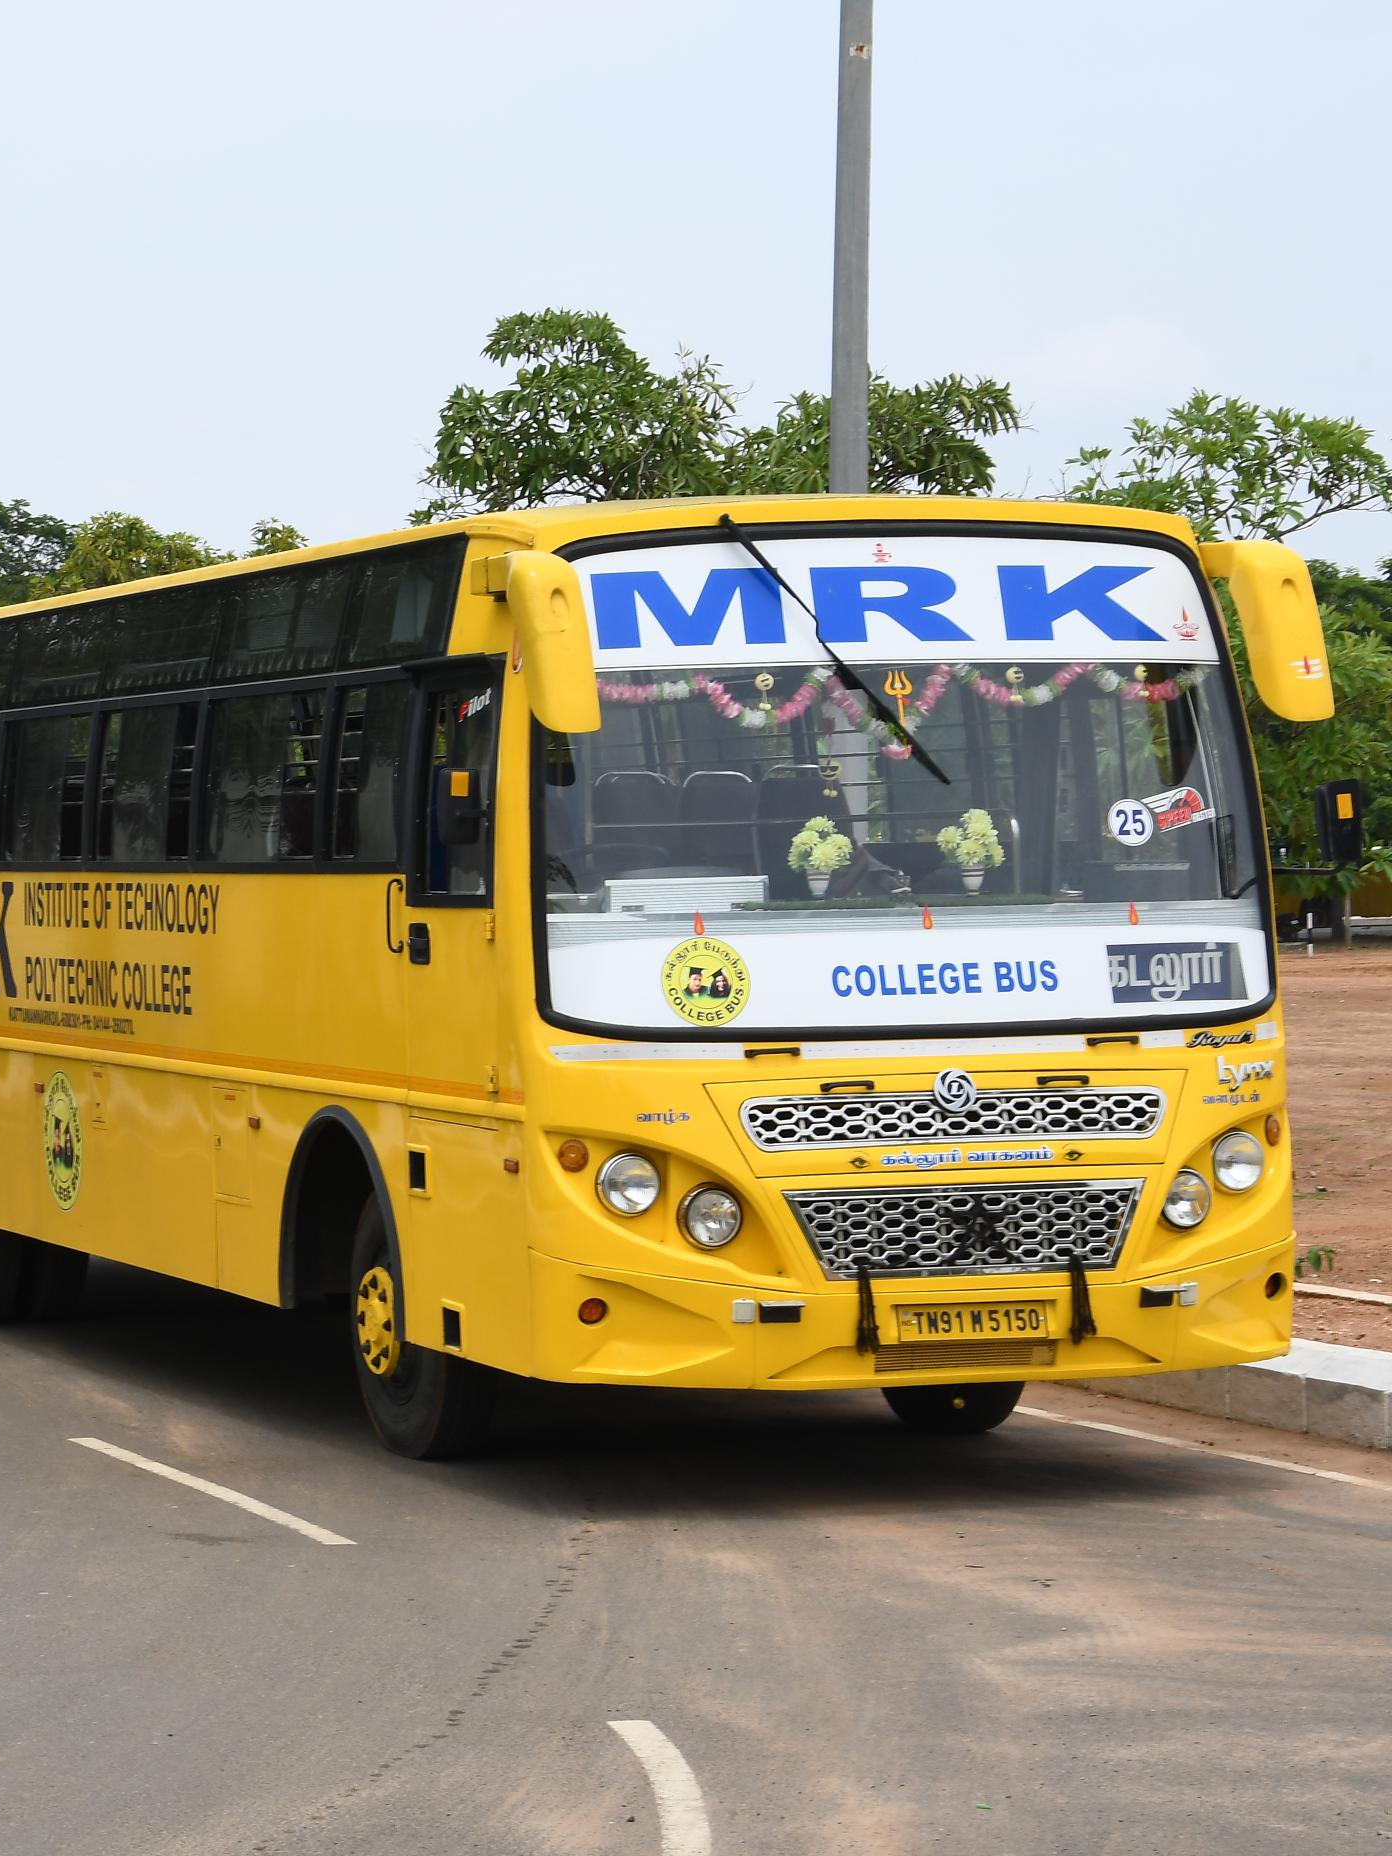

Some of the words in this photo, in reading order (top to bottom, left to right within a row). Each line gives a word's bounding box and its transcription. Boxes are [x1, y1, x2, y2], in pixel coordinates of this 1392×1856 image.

[589, 565, 1168, 651] MRK
[1115, 808, 1146, 836] 25
[24, 882, 89, 929] INSTITUTE
[93, 883, 112, 930] OF
[116, 882, 220, 935] TECHNOLOGY
[25, 955, 118, 1009] POLYTECHNIC
[121, 961, 193, 1016] COLLEGE
[831, 962, 983, 998] COLLEGE
[994, 960, 1059, 993] BUS
[1108, 942, 1224, 1002] கடலூர்
[668, 987, 725, 1022] COLLEGE
[724, 988, 745, 1014] BUS
[1216, 1055, 1275, 1092] Lynx
[881, 1150, 962, 1168] கல்லூரி
